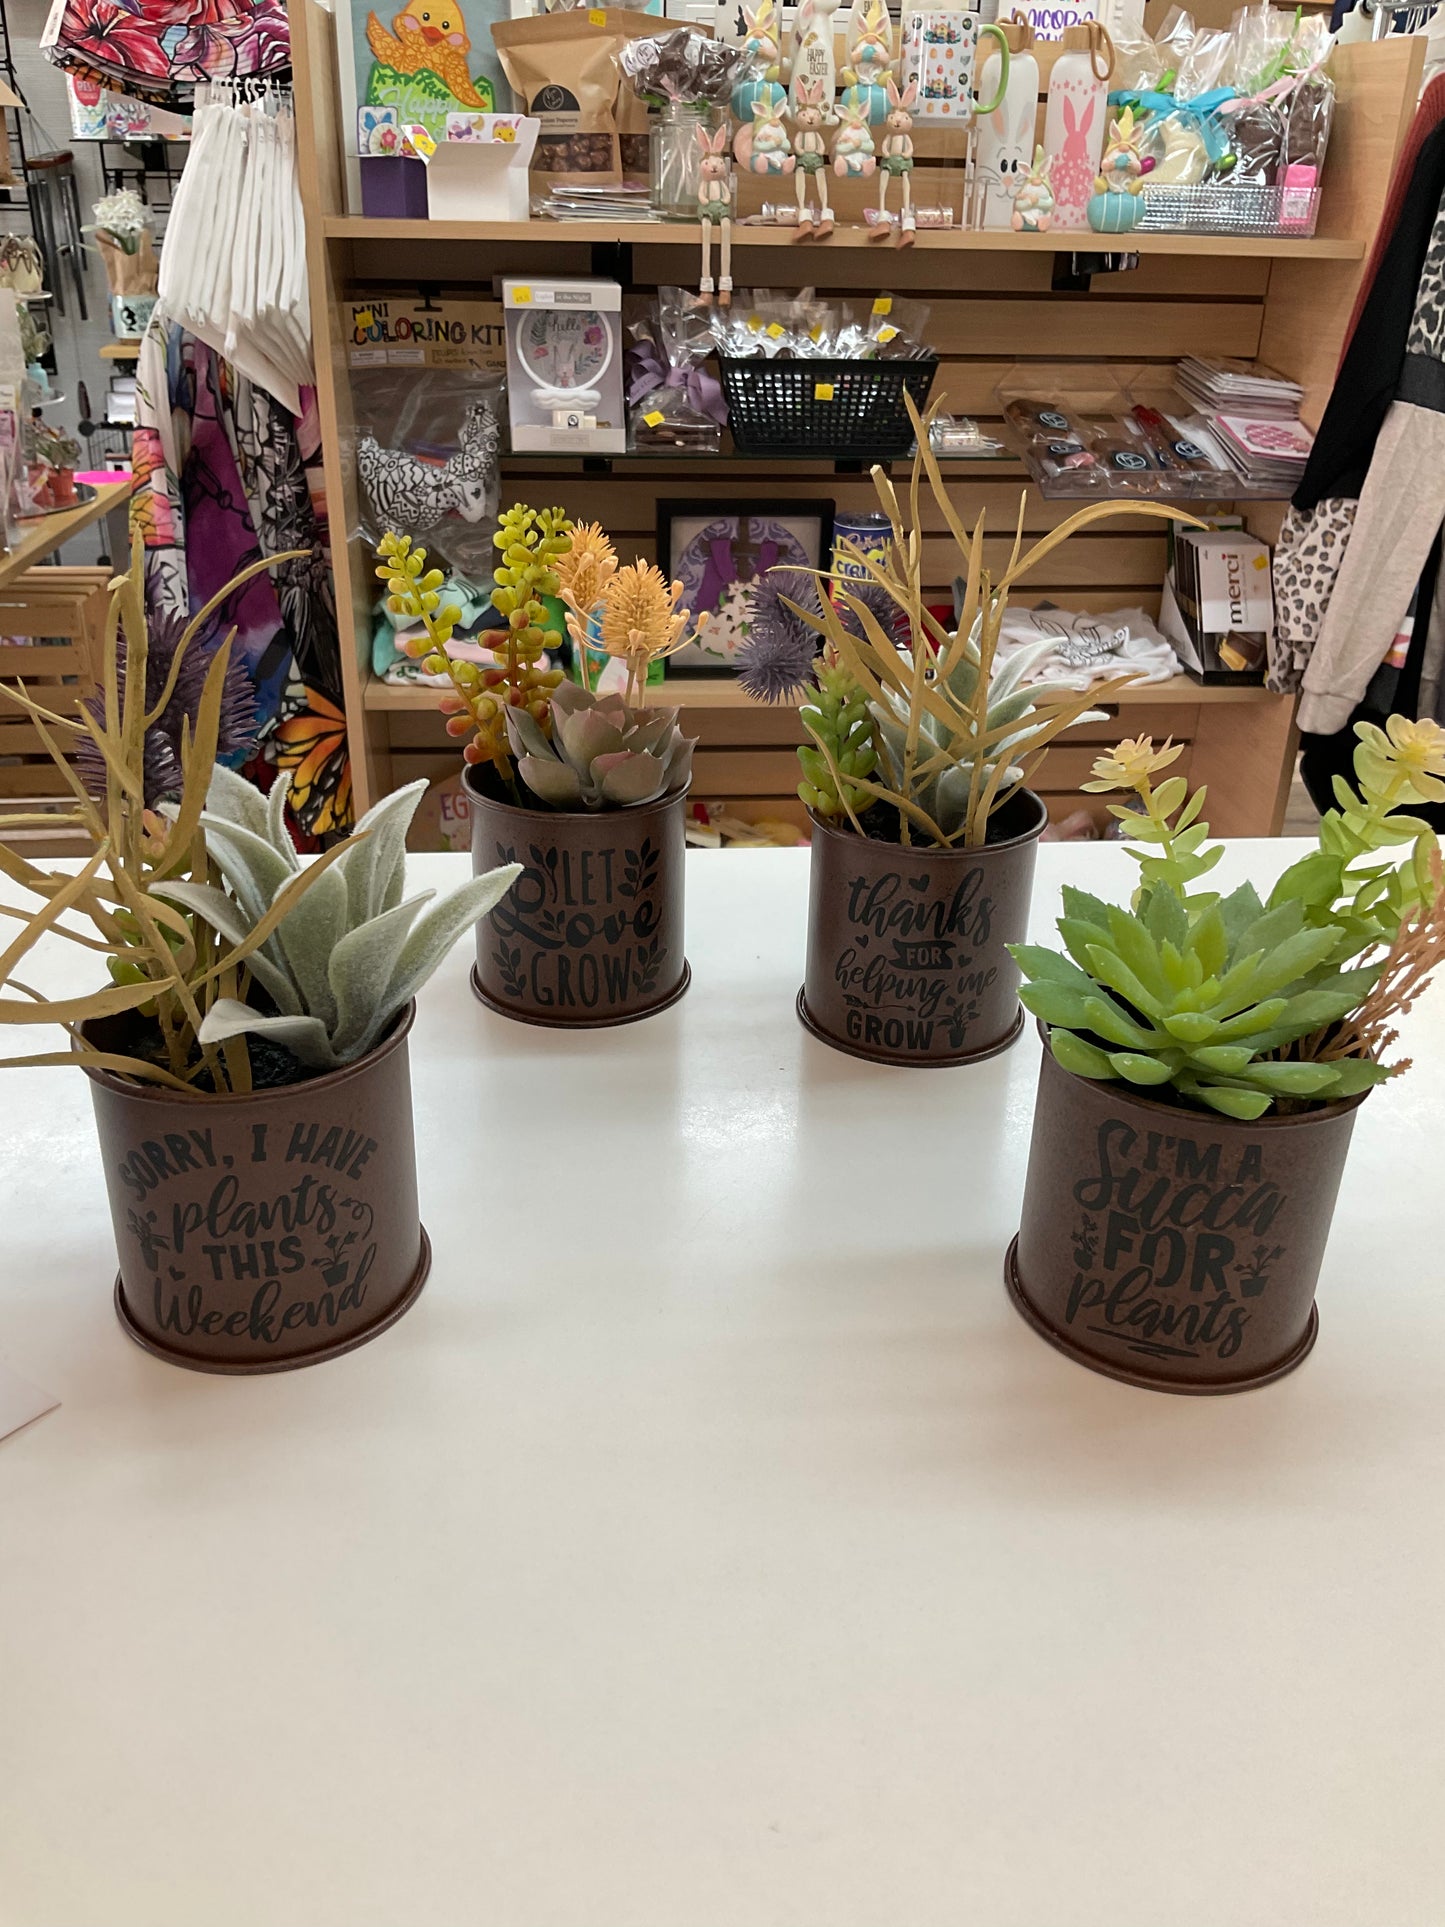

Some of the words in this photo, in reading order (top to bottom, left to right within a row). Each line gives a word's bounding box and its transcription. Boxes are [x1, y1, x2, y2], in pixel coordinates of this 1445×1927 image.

[807, 49, 825, 62] HAPPY
[809, 62, 828, 75] EASTER
[353, 318, 467, 345] COLORING
[1221, 553, 1242, 625] merci
[489, 866, 663, 950] Love
[562, 849, 616, 906] LET
[848, 867, 997, 946] thanks
[530, 947, 633, 1008] GROW
[835, 948, 951, 1018] helping
[957, 966, 998, 996] me
[906, 948, 942, 966] FOR
[846, 1009, 935, 1050] GROW
[118, 1127, 235, 1202] SORRY,
[251, 1123, 268, 1163] I
[285, 1123, 379, 1181] HAVE
[1072, 1118, 1288, 1237] Succa
[1142, 1130, 1223, 1182] I'M
[1236, 1144, 1263, 1184] A
[172, 1174, 338, 1254] plants
[202, 1235, 306, 1280] THIS
[1103, 1209, 1236, 1293] FOR
[154, 1243, 378, 1344] Weekend
[1065, 1265, 1253, 1358] plants
